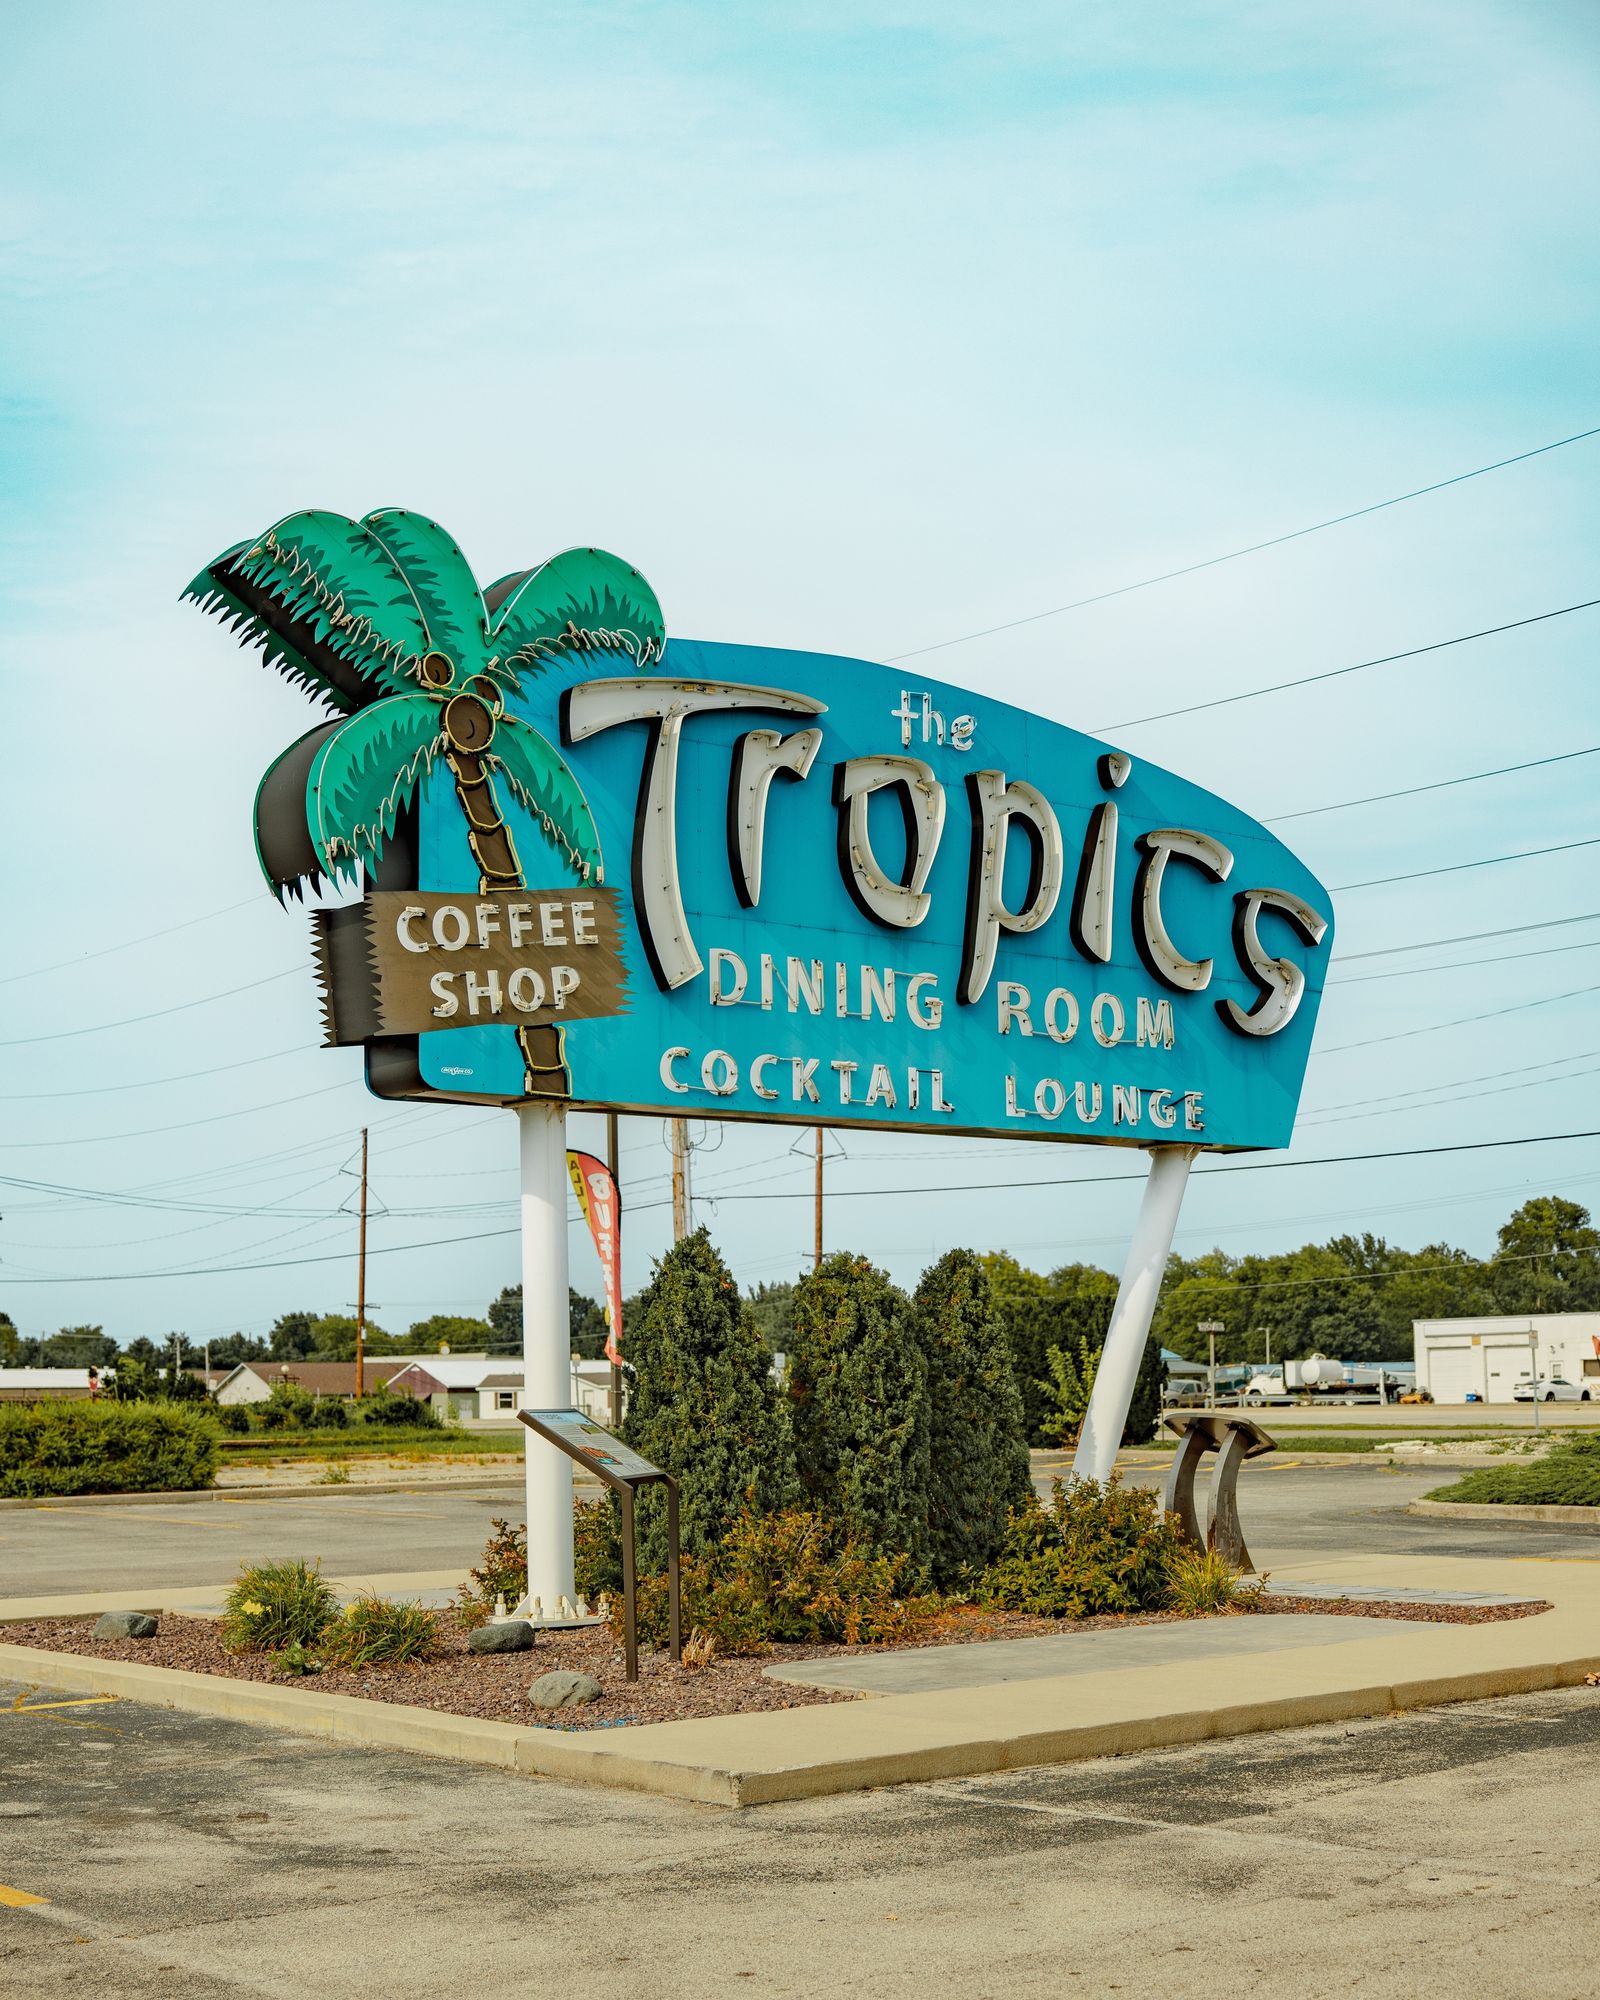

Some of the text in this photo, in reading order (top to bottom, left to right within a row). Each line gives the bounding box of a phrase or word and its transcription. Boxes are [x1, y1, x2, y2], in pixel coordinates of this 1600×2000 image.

[891, 690, 977, 752] the
[559, 677, 1328, 1036] Tropics
[396, 901, 599, 952] COFFEE
[430, 966, 581, 1017] SHOP
[709, 948, 1175, 1050] DINING ROOM
[660, 1046, 1205, 1131] COCKTAIL LOUNGE
